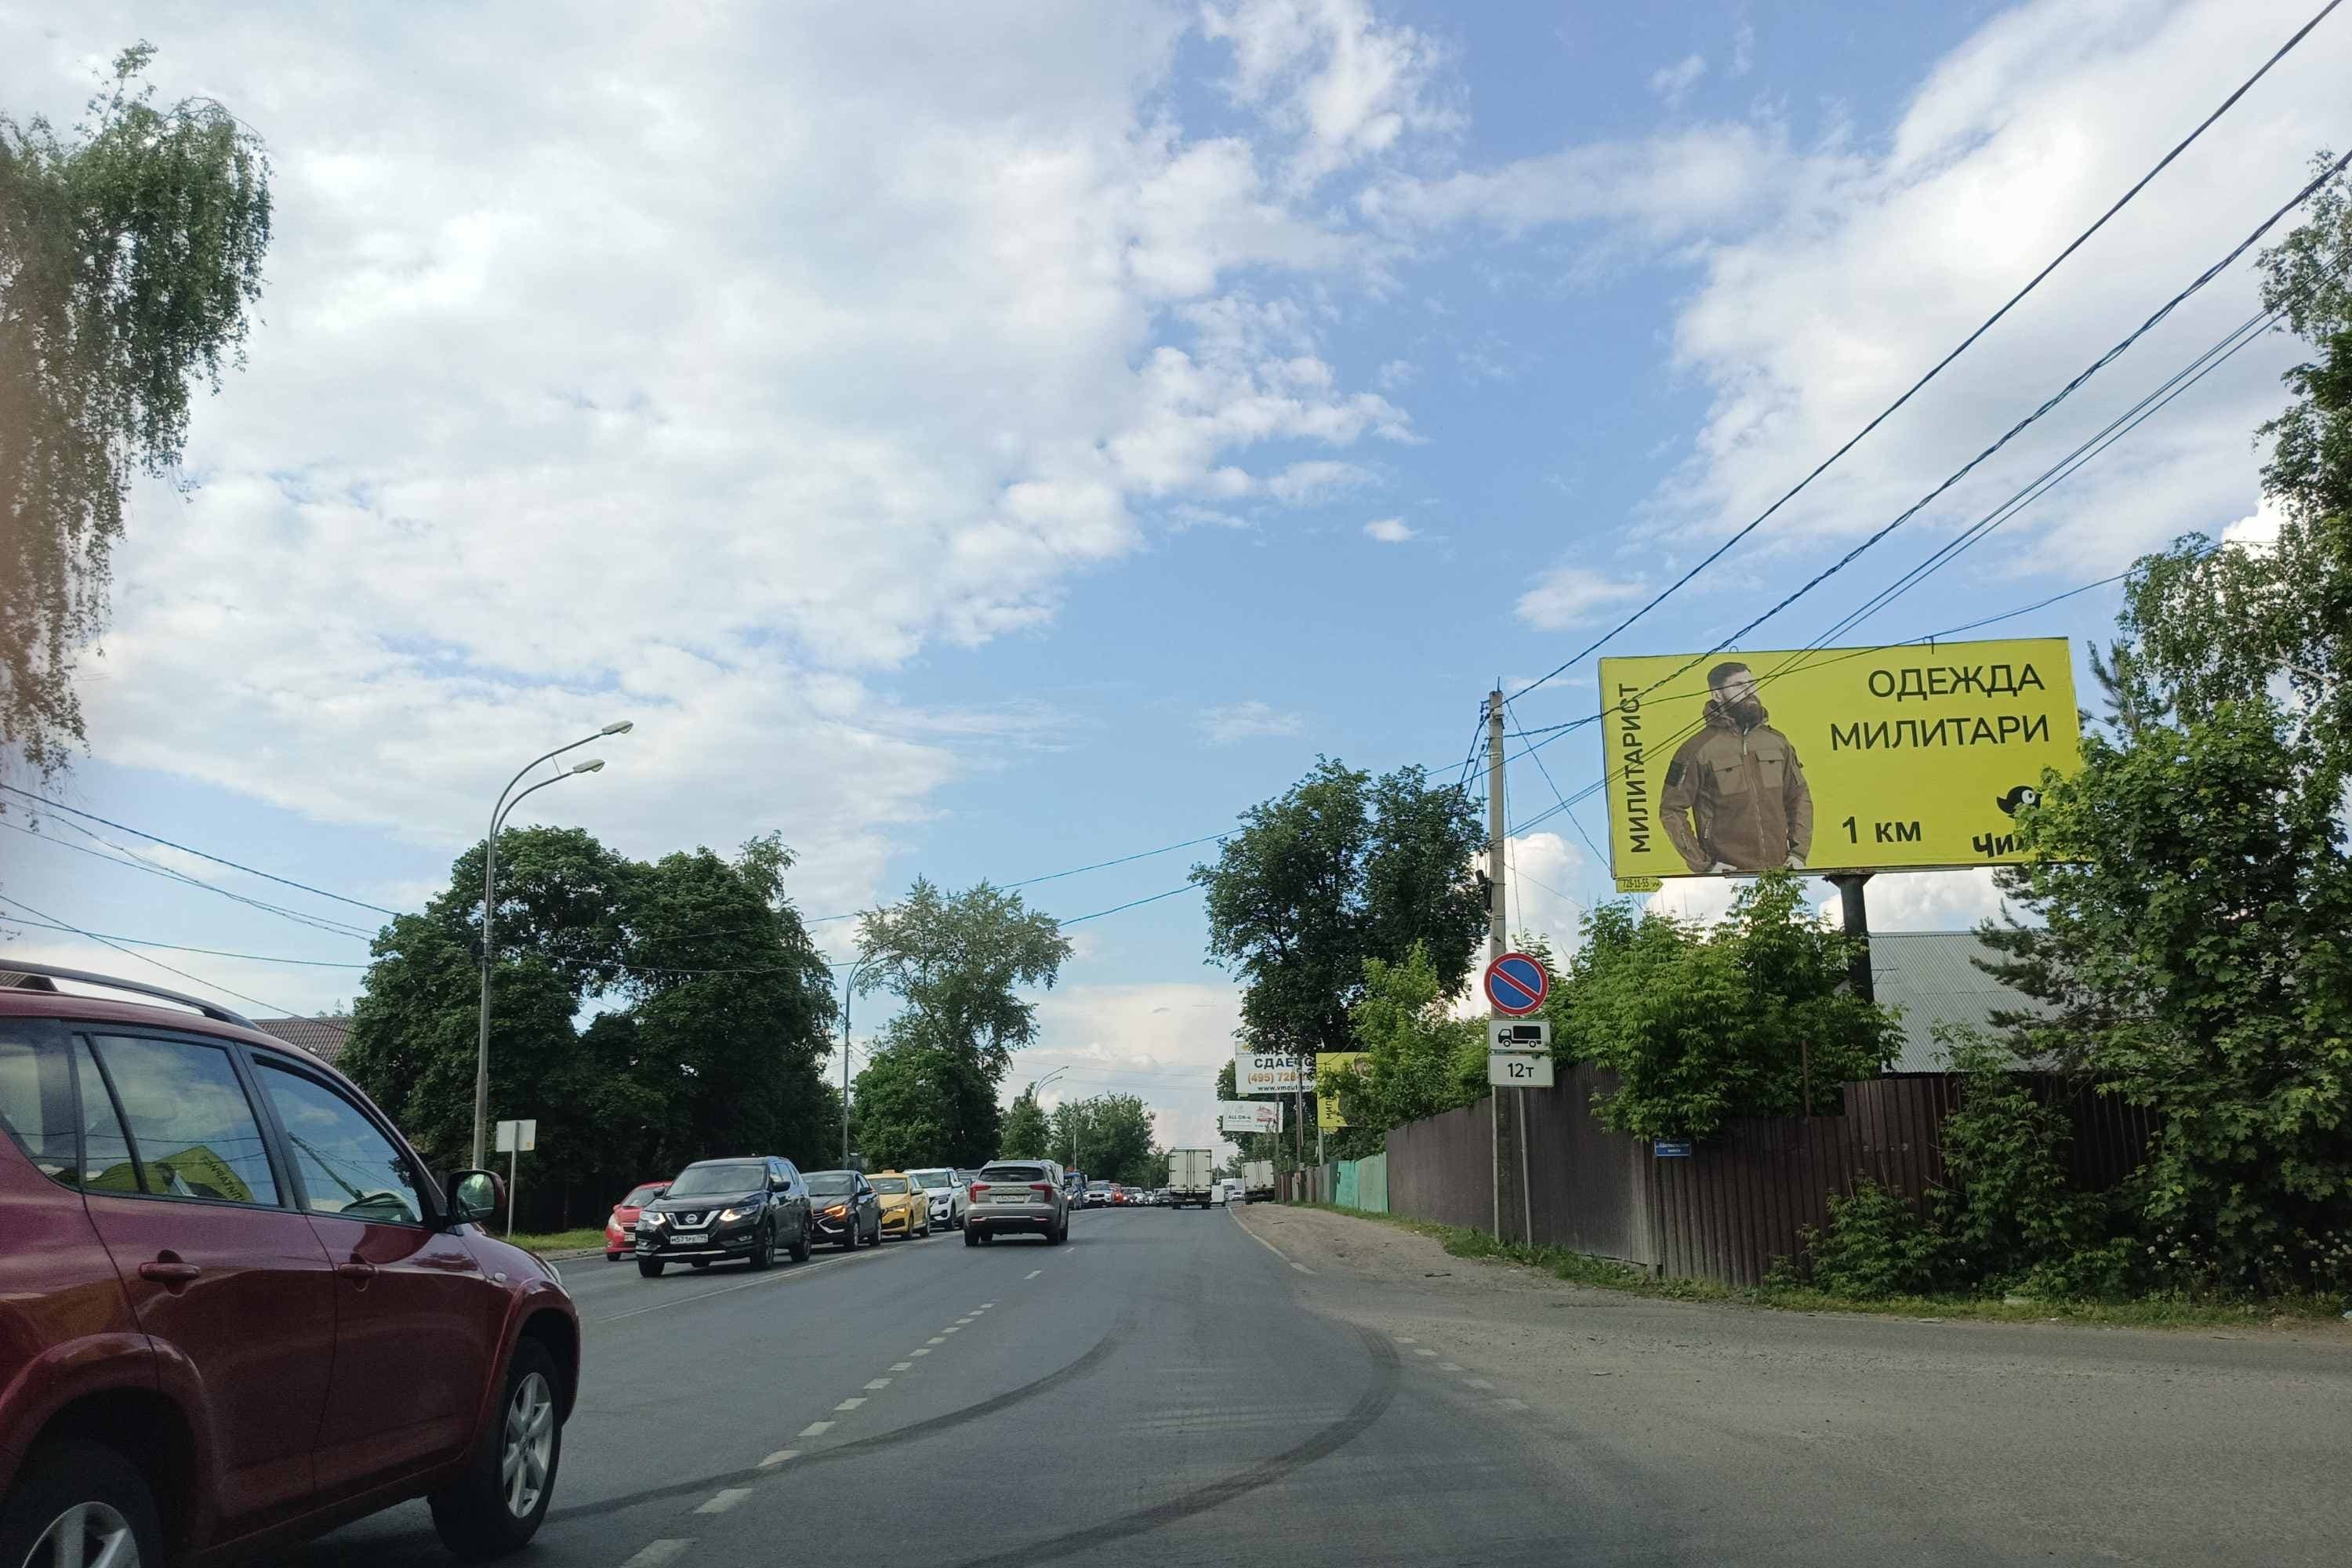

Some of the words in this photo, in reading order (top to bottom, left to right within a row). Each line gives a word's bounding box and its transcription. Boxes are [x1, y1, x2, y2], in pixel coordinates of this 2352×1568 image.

[1867, 663, 2045, 702] ОДЕЖДА
[1830, 714, 2049, 751] МИЛИТАРИ
[1618, 683, 1651, 853] МИЛИТАРИСТ
[1842, 815, 1857, 844] 1
